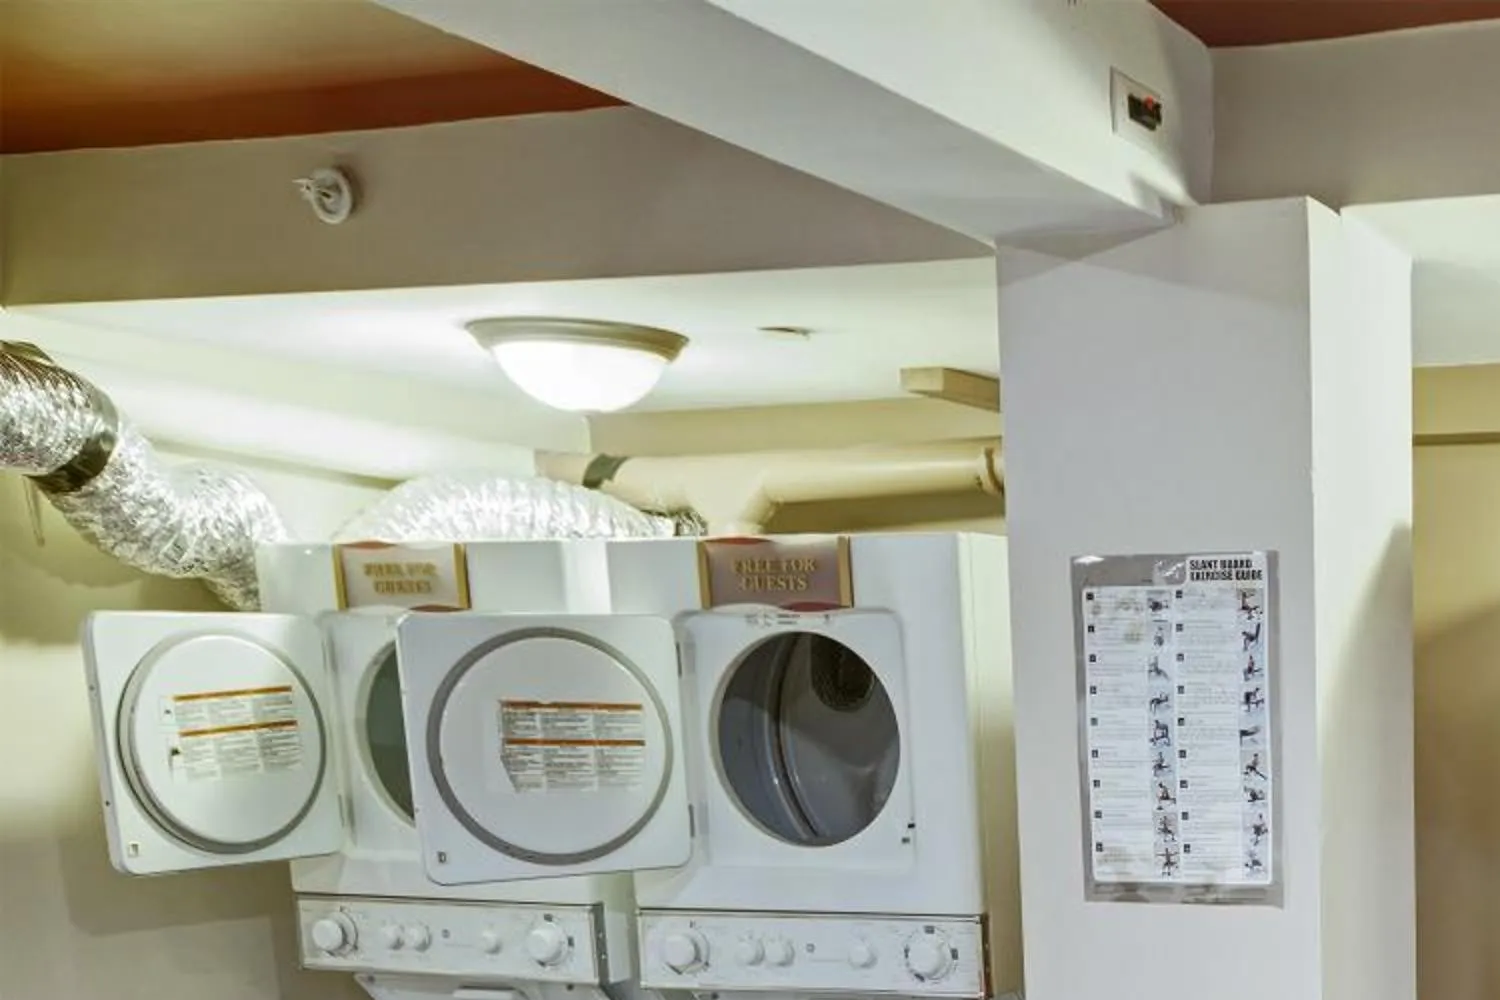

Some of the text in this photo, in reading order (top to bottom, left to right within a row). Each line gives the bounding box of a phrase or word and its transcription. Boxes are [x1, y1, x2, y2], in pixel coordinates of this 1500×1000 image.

[732, 557, 817, 574] FREE FOR
[739, 574, 808, 592] GUESTS
